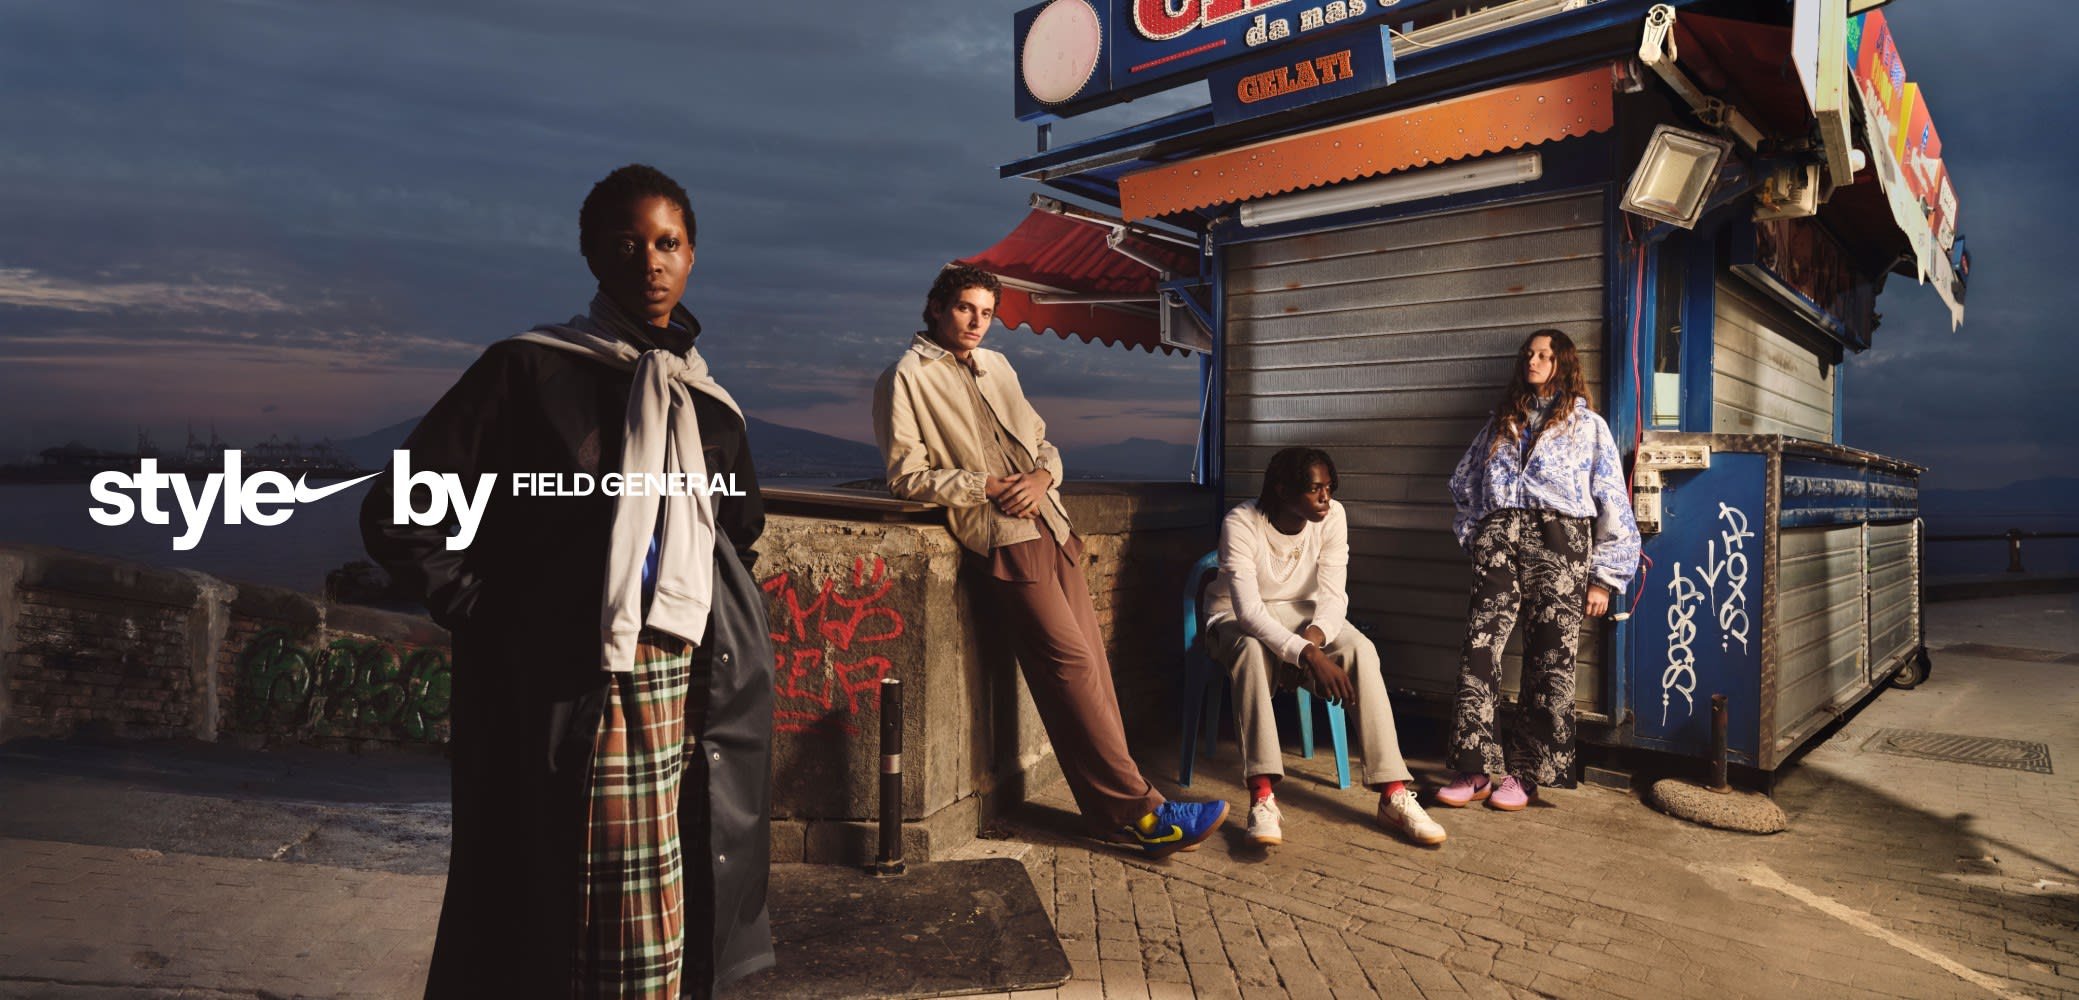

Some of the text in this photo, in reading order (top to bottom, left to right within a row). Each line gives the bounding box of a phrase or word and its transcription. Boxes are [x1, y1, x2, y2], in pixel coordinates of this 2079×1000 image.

[1245, 14, 1290, 47] da
[1300, 0, 1367, 32] nas
[1237, 50, 1353, 104] GELATI
